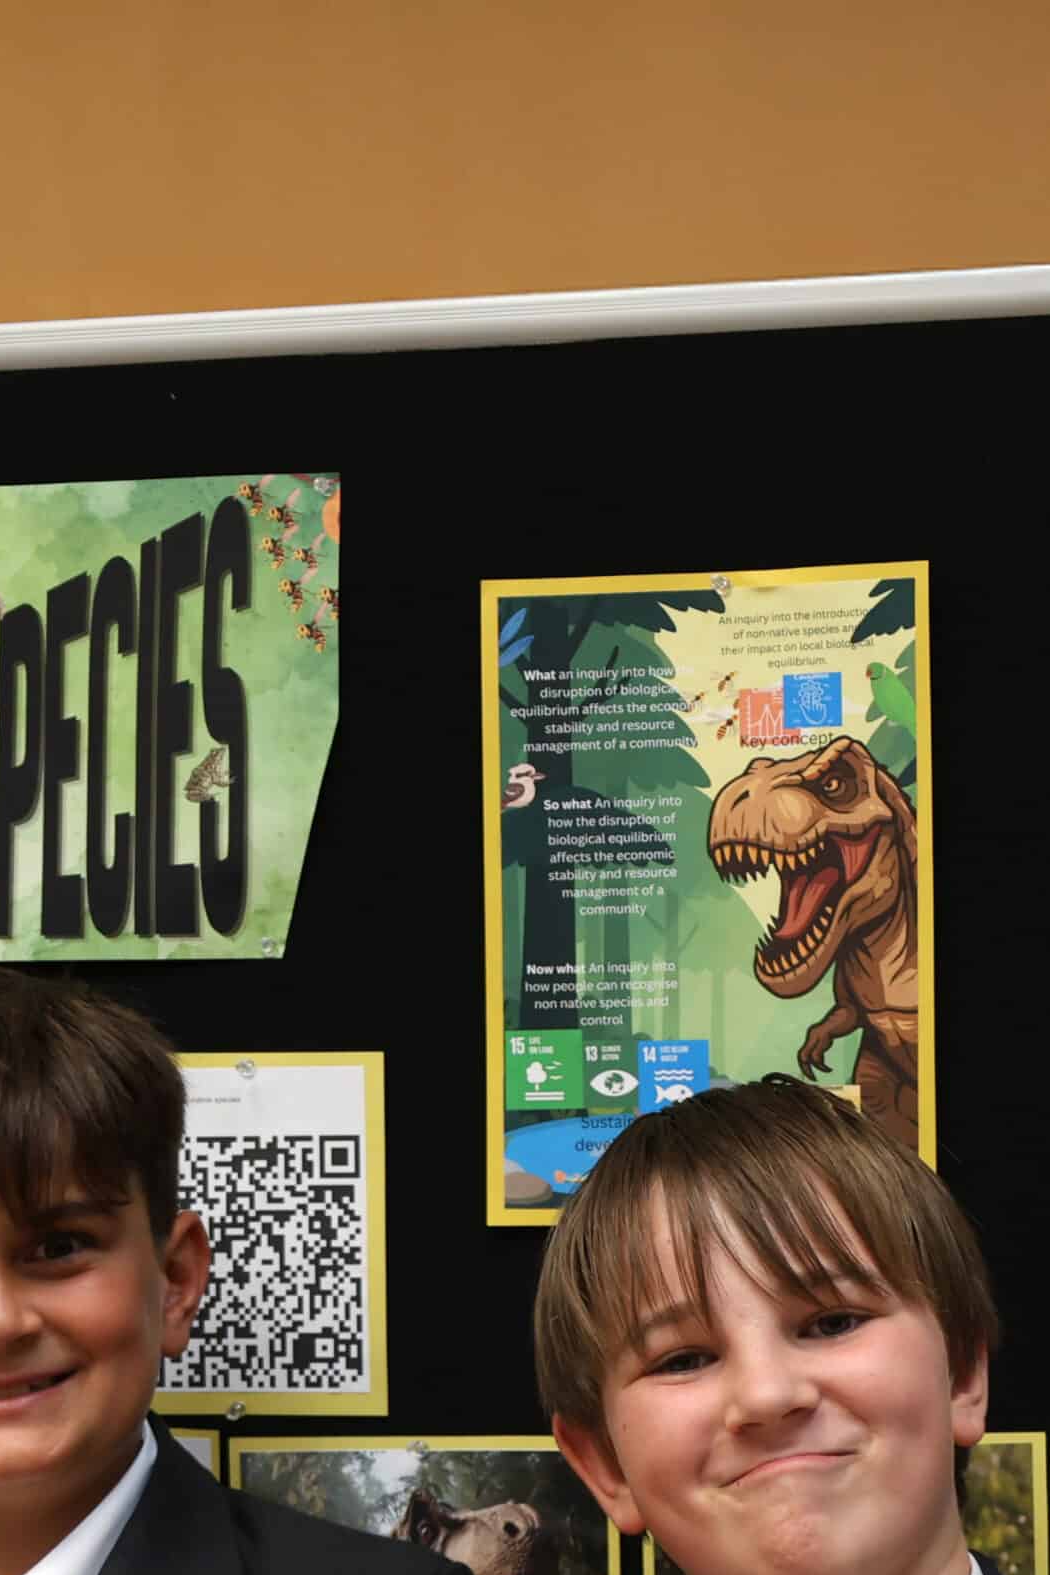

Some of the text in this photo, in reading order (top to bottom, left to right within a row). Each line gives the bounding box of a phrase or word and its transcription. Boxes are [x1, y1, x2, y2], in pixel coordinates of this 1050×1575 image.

[718, 611, 810, 626] An inquiry into the
[733, 624, 839, 639] of non-native species
[721, 640, 823, 656] their impact on local
[524, 666, 673, 681] What an inquiry into how
[540, 685, 618, 700] disruption of
[510, 702, 647, 719] equilibrium affects the
[545, 720, 675, 735] stability and resource
[523, 741, 600, 754] management
[604, 739, 617, 749] of
[620, 741, 626, 749] a
[740, 732, 833, 751] Key concept
[543, 796, 682, 811] So what An inquiry into
[547, 812, 676, 828] how the disruption of
[548, 831, 676, 847] biological equilibrium
[550, 848, 675, 864] affects the economic
[548, 868, 677, 882] stability and resource
[562, 884, 664, 900] management of a
[579, 903, 647, 917] community
[526, 964, 555, 975] Now
[556, 963, 586, 974] what
[588, 963, 604, 973] An
[607, 962, 649, 974] inquiry
[525, 982, 550, 992] how
[552, 981, 595, 995] people
[596, 982, 618, 991] can
[534, 1000, 557, 1009] non
[560, 998, 597, 1009] native
[600, 998, 643, 1010] species
[580, 1015, 623, 1026] control
[510, 1036, 525, 1055] 15
[585, 1046, 598, 1062] 13
[643, 1046, 657, 1063] 14
